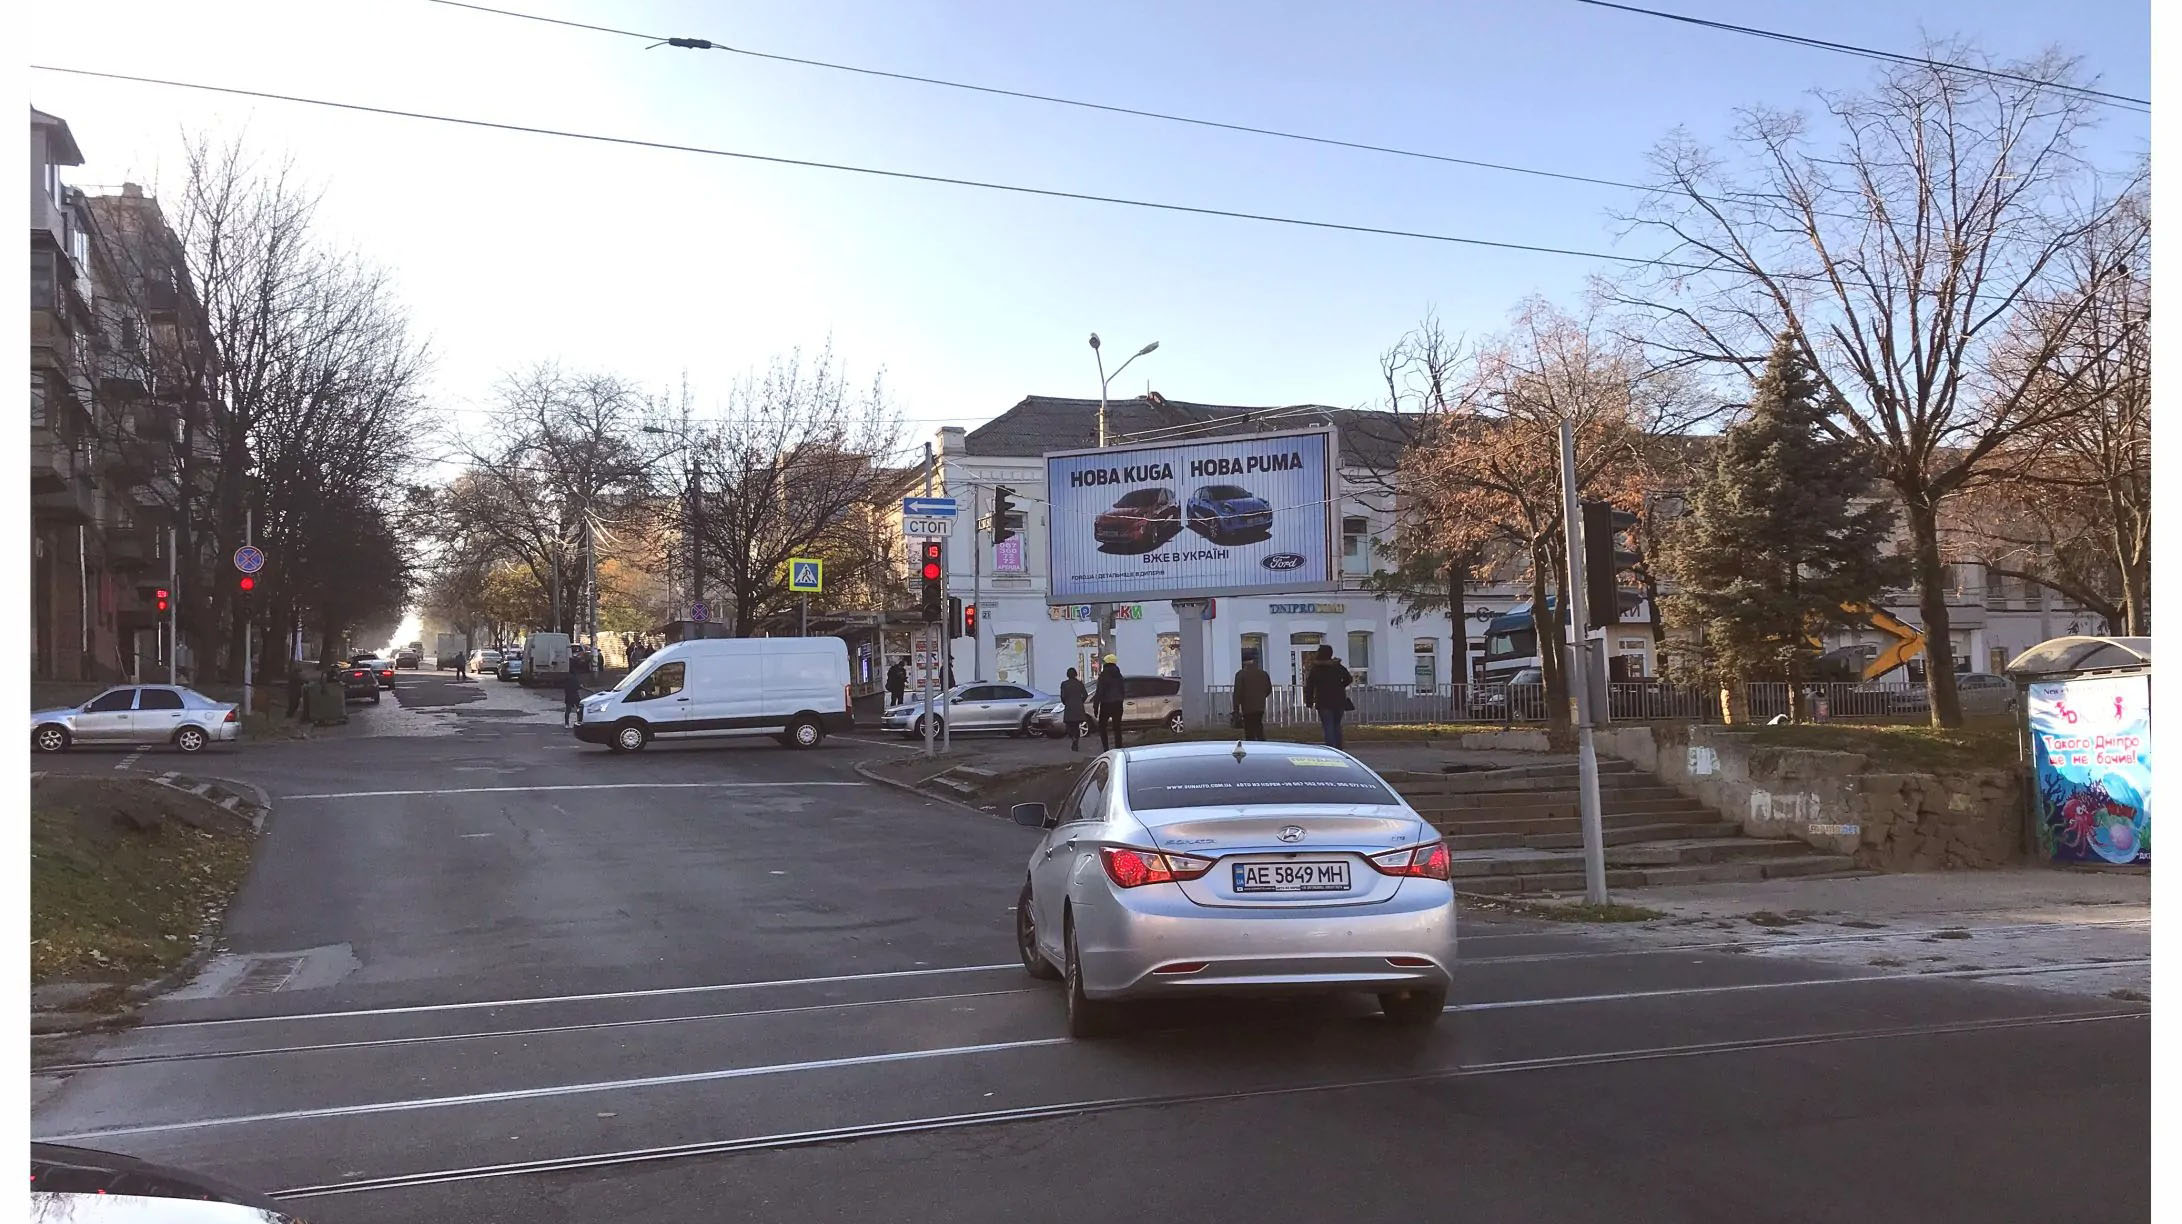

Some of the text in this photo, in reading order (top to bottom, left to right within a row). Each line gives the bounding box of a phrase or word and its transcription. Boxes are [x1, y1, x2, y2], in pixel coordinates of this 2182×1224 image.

[1190, 452, 1303, 477] НОВА PUMA
[1071, 463, 1173, 488] НОВА KUGA
[909, 520, 947, 534] СТОП
[1143, 549, 1229, 564] ВЖЕ В УКРАЇНІ
[1270, 555, 1297, 569] Ford
[2045, 736, 2140, 750] Такого Дніпро
[2073, 756, 2088, 764] не
[2097, 750, 2136, 764] бачив!
[1246, 865, 1343, 884] AE 5849 MH
